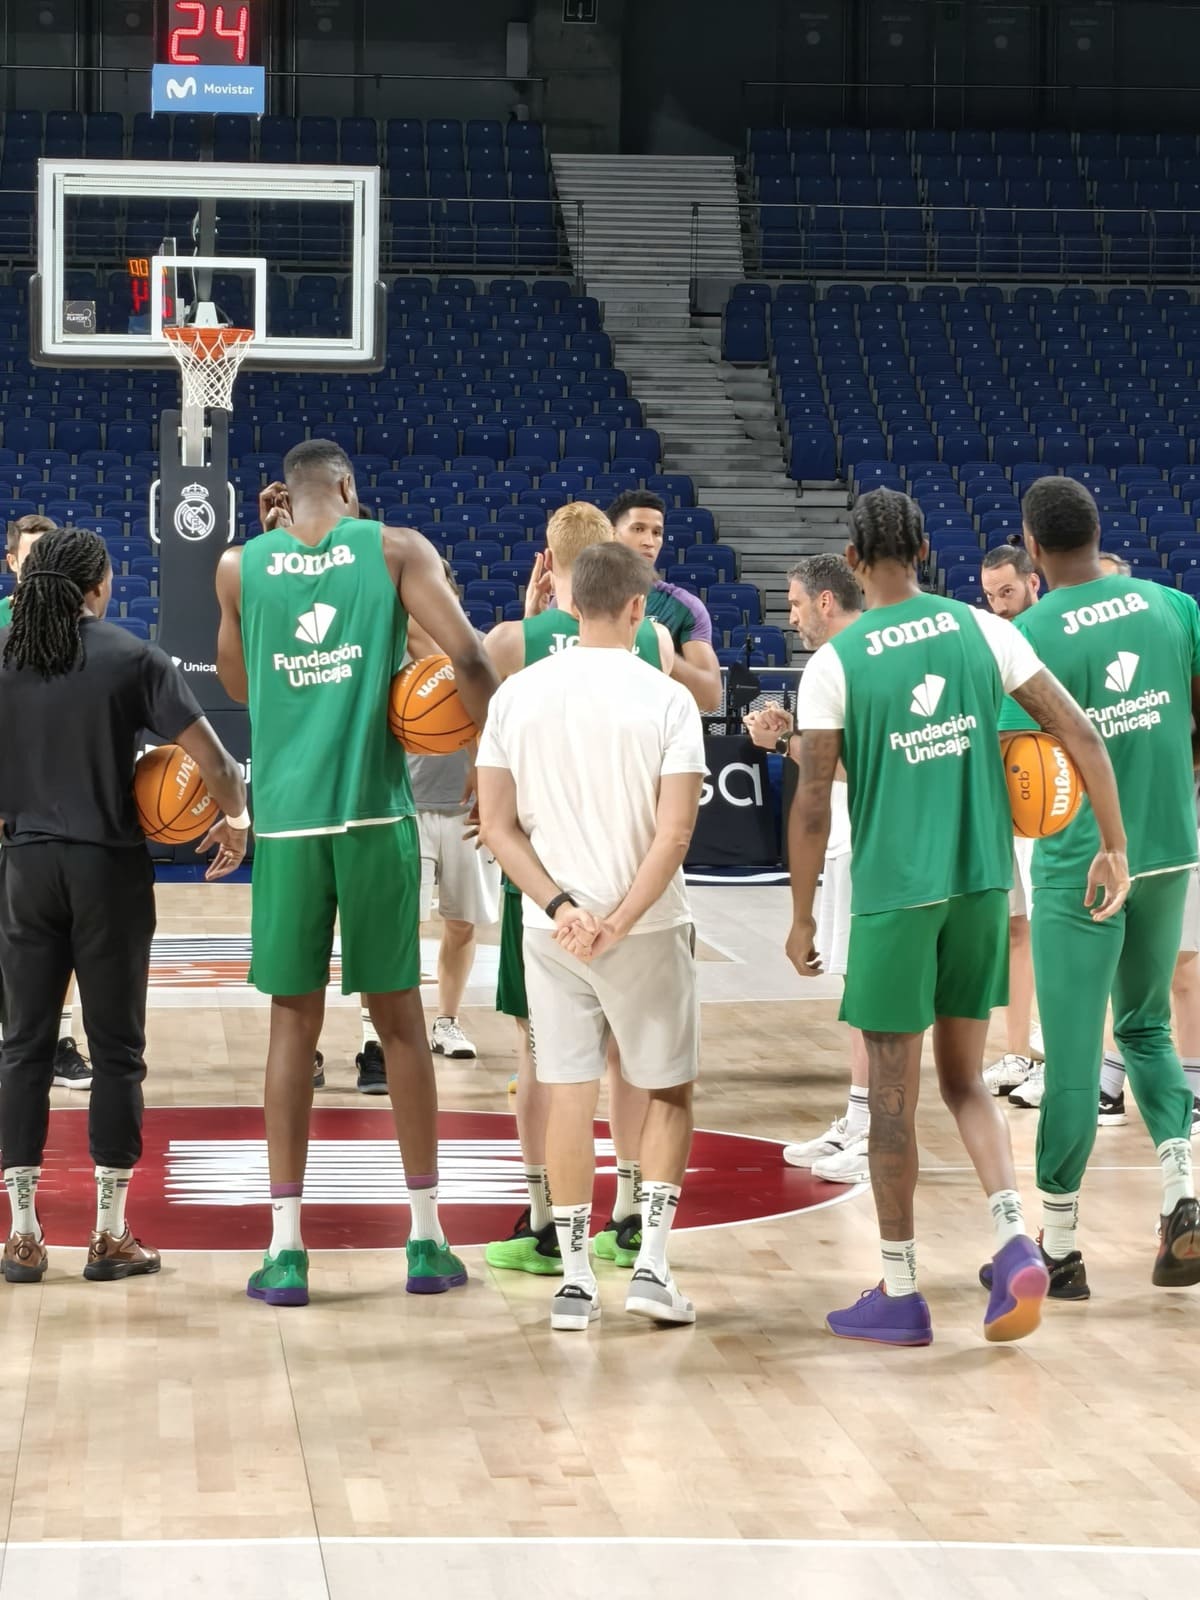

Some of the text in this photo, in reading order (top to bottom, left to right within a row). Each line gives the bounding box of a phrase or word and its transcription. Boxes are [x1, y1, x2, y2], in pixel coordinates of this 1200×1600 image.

[170, 2, 248, 62] 24
[203, 83, 255, 95] Movistar
[183, 662, 218, 674] Unica
[273, 643, 363, 671] Fundación
[289, 662, 353, 687] Unicaja
[1086, 689, 1171, 723] Fundación
[889, 713, 977, 750] Fundación
[1100, 709, 1161, 738] Unicaja
[904, 734, 971, 765] Unicaja
[1018, 770, 1031, 800] acb
[1050, 746, 1071, 816] Wilson
[16, 1175, 31, 1211] UNICAJA
[99, 1176, 114, 1211] UNICAJA
[647, 1191, 668, 1228] UNICAJA
[570, 1215, 586, 1253] UNICAJA
